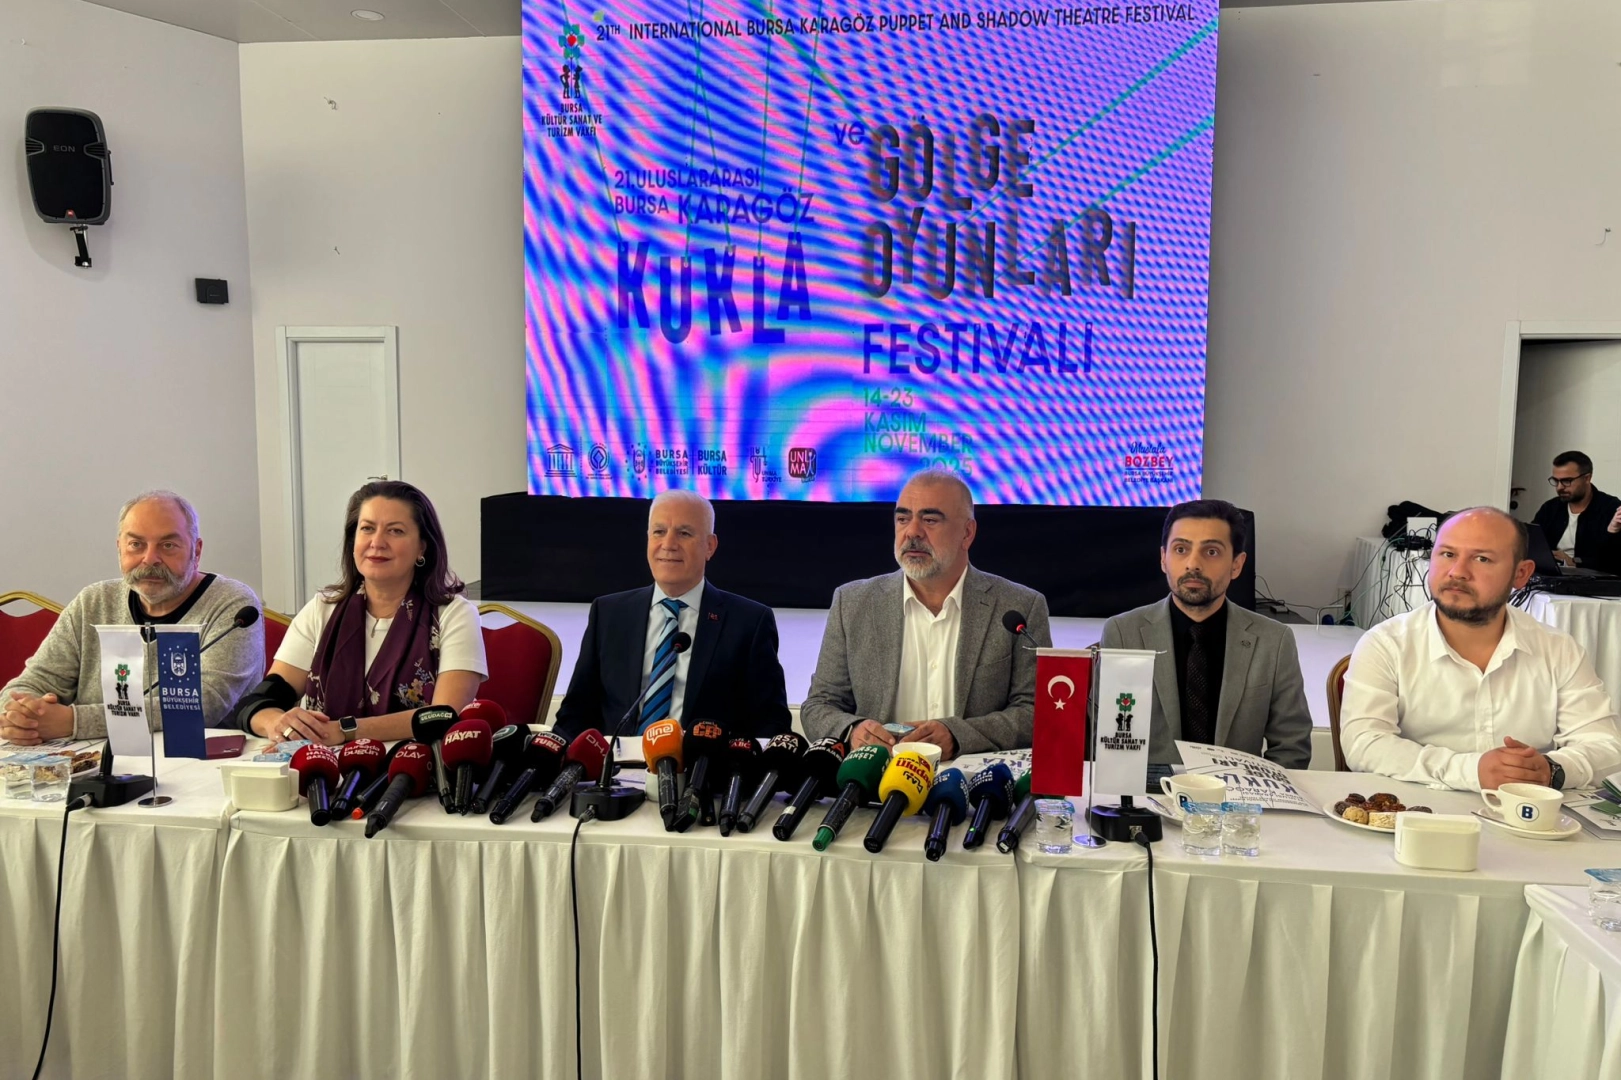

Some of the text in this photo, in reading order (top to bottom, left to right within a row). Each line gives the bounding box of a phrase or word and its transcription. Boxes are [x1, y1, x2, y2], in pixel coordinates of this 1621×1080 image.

[629, 20, 742, 40] INTERNATIONAL
[747, 18, 795, 36] BURSA
[800, 14, 874, 34] KARAGÖZ
[879, 14, 934, 32] PUPPET
[939, 12, 972, 30] AND
[977, 9, 1049, 29] SHADOW
[1055, 7, 1120, 27] THEATRE
[1125, 4, 1195, 24] FESTIVAL
[560, 103, 583, 113] BURSA
[541, 113, 602, 125] KÜLTÜR SANAT VE
[833, 119, 865, 146] ve
[615, 187, 815, 225] BURSA KARAGÖZ
[863, 206, 1136, 300] OYUNLARI
[617, 231, 813, 344] KUKLA
[863, 387, 914, 408] 14-23
[864, 411, 927, 432] KASIM
[864, 432, 974, 454] NOVEMBER
[655, 449, 689, 459] BURSA
[697, 449, 728, 462] BURSA
[1125, 456, 1173, 467] BOZBEY
[697, 463, 728, 476] KÜLTÜR
[162, 687, 199, 697] BURSA
[395, 750, 426, 759] OLAY
[1521, 805, 1534, 819] B
